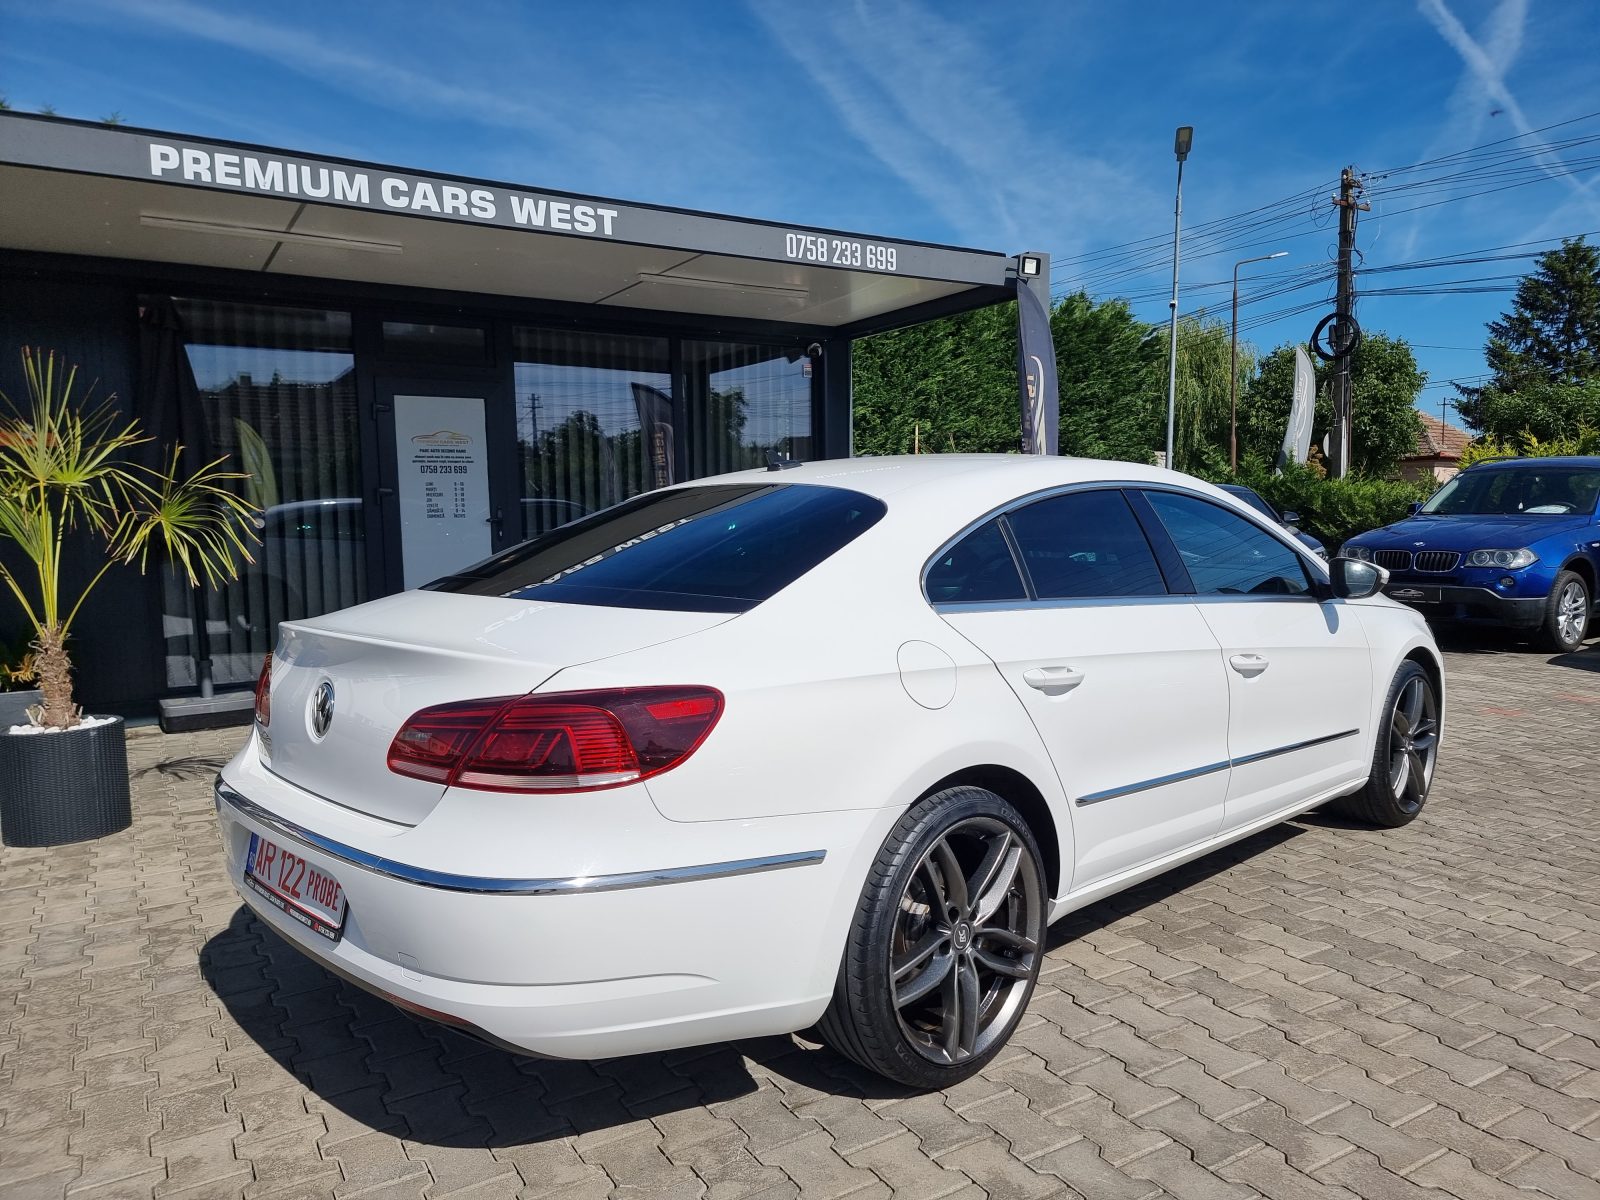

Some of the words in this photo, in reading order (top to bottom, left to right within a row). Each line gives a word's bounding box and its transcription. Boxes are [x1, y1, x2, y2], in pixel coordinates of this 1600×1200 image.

[149, 143, 370, 205] PREMIUM
[381, 177, 497, 219] CARS
[510, 196, 619, 236] WEST
[785, 233, 828, 263] 0758
[832, 240, 862, 267] 233
[866, 244, 898, 271] 699
[420, 465, 438, 474] 0758
[439, 465, 452, 474] 233
[453, 465, 468, 474] 699
[255, 838, 277, 881] AR
[277, 849, 306, 899] 122
[306, 870, 342, 912] PROBE
